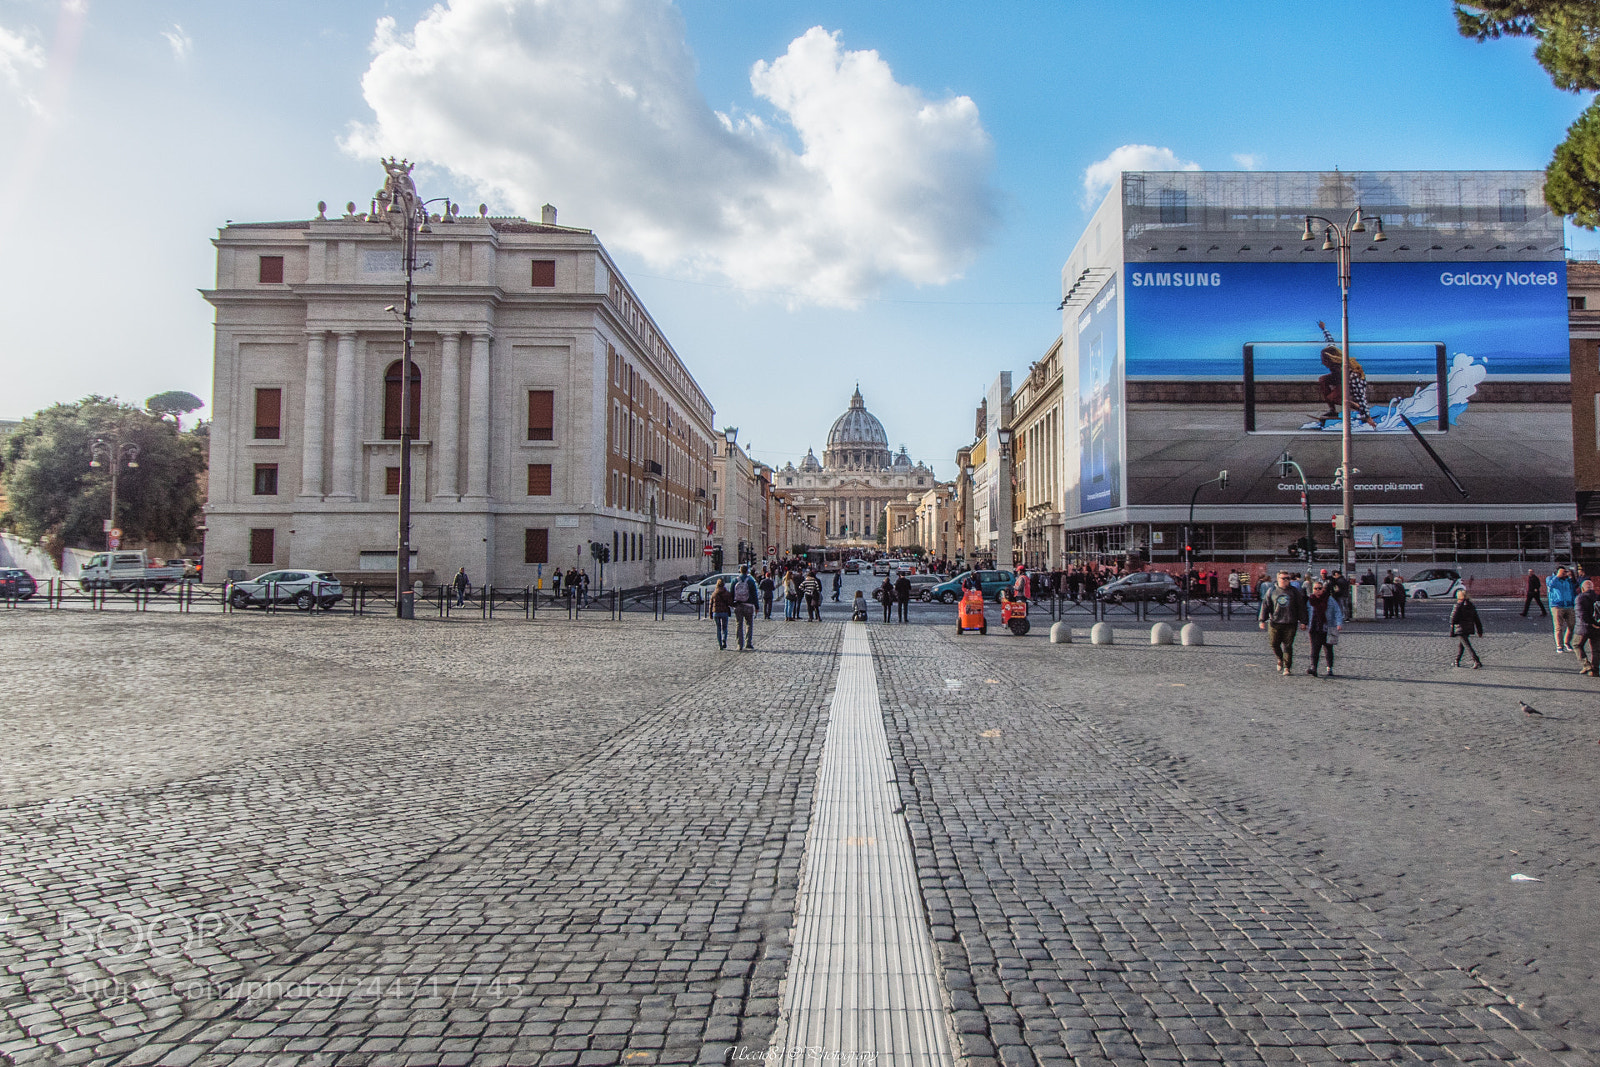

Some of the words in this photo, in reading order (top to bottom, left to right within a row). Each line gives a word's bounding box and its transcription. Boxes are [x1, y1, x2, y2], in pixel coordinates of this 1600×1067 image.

[1132, 272, 1221, 287] SAMSUNG
[1440, 272, 1503, 290] Galaxy
[1505, 271, 1558, 286] Note8
[1277, 483, 1295, 491] Con
[1353, 483, 1384, 491] ancora
[1398, 483, 1424, 491] smart
